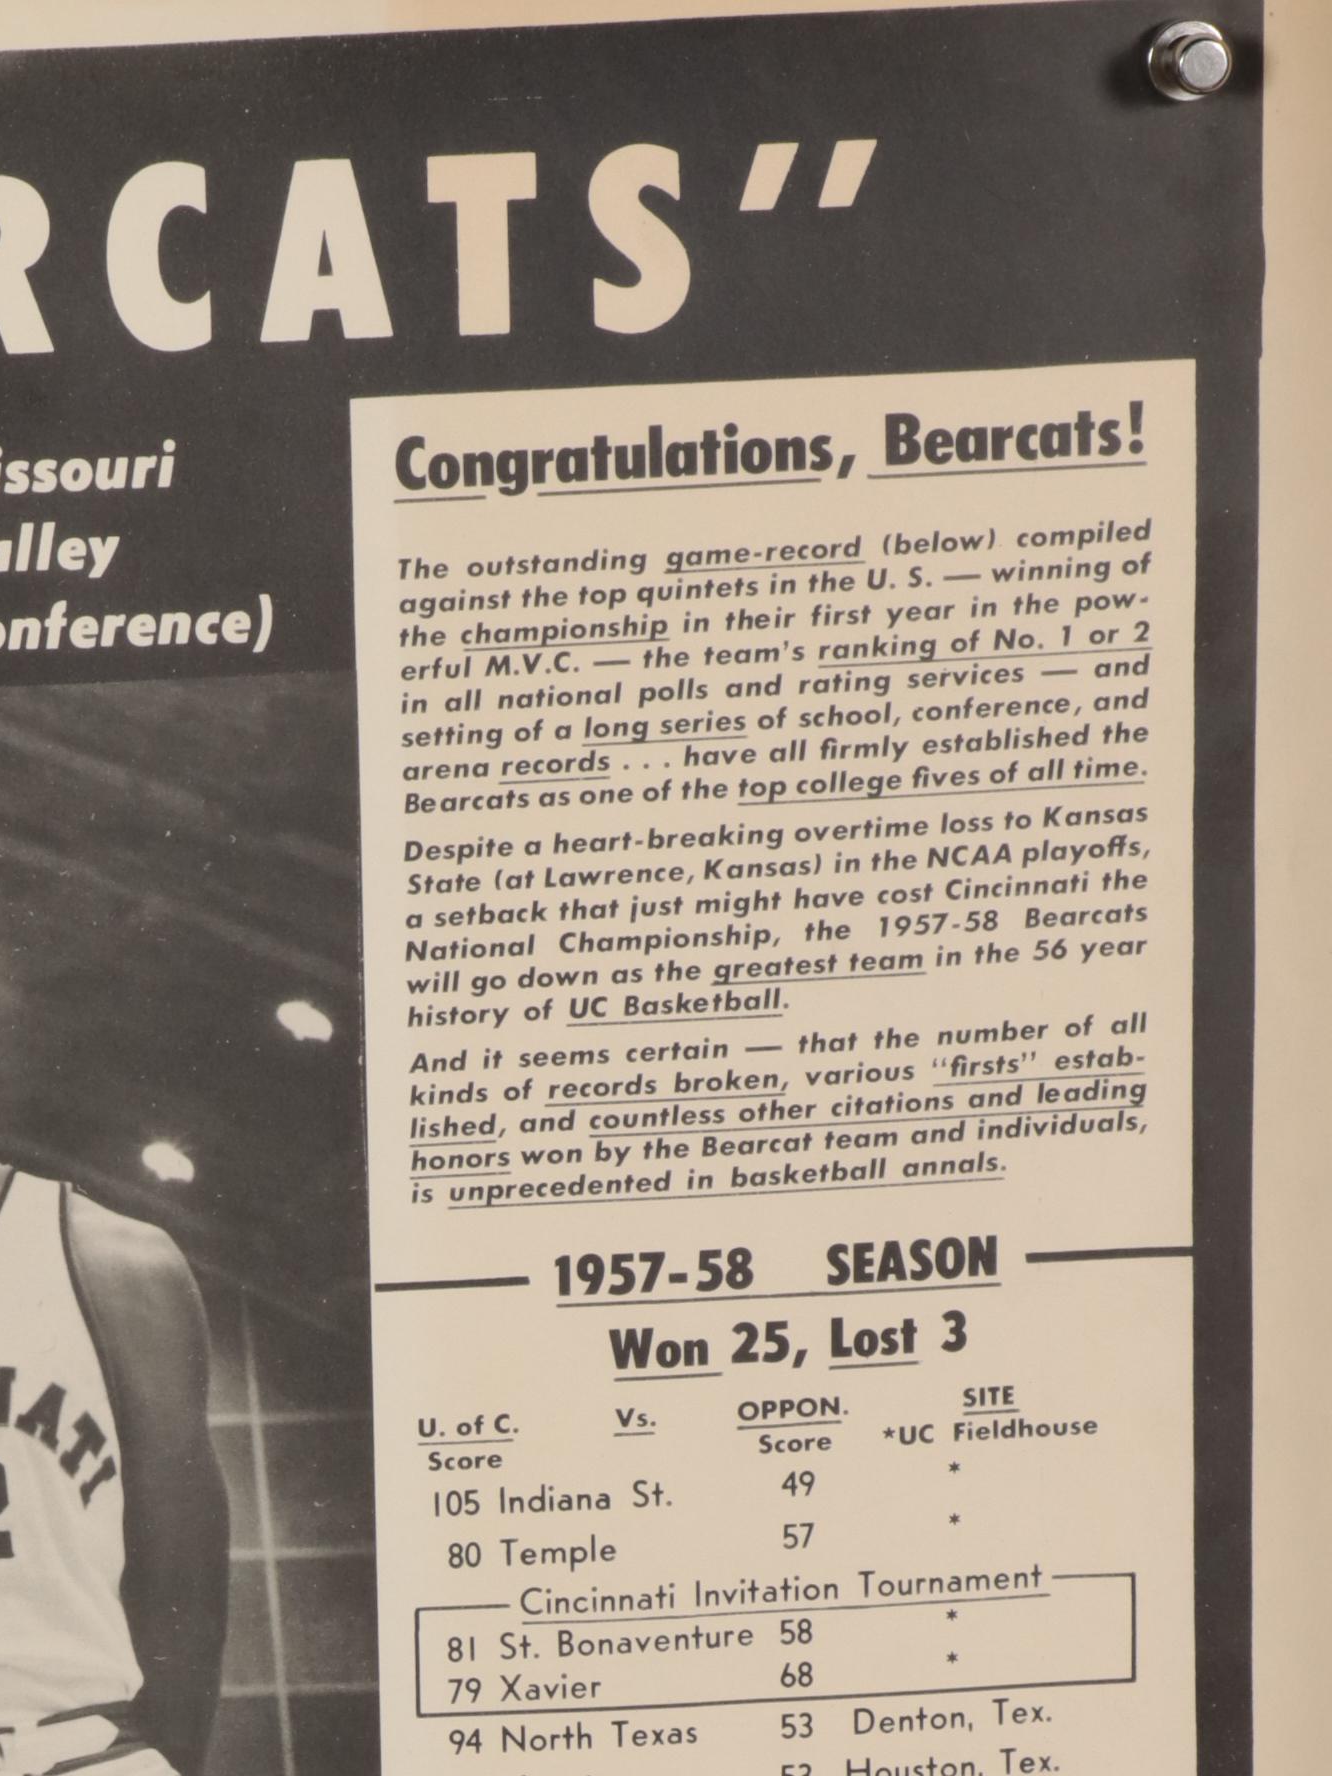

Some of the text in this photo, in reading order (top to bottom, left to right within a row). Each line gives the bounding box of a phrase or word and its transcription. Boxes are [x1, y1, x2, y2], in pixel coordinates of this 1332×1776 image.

[395, 400, 1144, 497] Congratulations, Bearcats!
[398, 517, 1152, 580] The outstanding game-record (below) compiled
[405, 903, 1148, 962] National Championship, the 1957-58 Bearcats
[407, 987, 789, 1029] history of UC Basketball.
[411, 1109, 1147, 1172] honors won by the Bearcat team and individuals,
[554, 1234, 998, 1297] 1957-58 SEASON
[608, 1308, 968, 1370] Won 25, Lost 3
[418, 1385, 1015, 1438] U. of C. Vs. OPPON. SITE
[428, 1433, 832, 1472] Score Score
[434, 1469, 816, 1518] 105 Indiana St. 49
[520, 1565, 1043, 1616] Cincinnati Invitation Tournament
[448, 1697, 1052, 1756] 94 North Texas 53 Denton, Tex.
